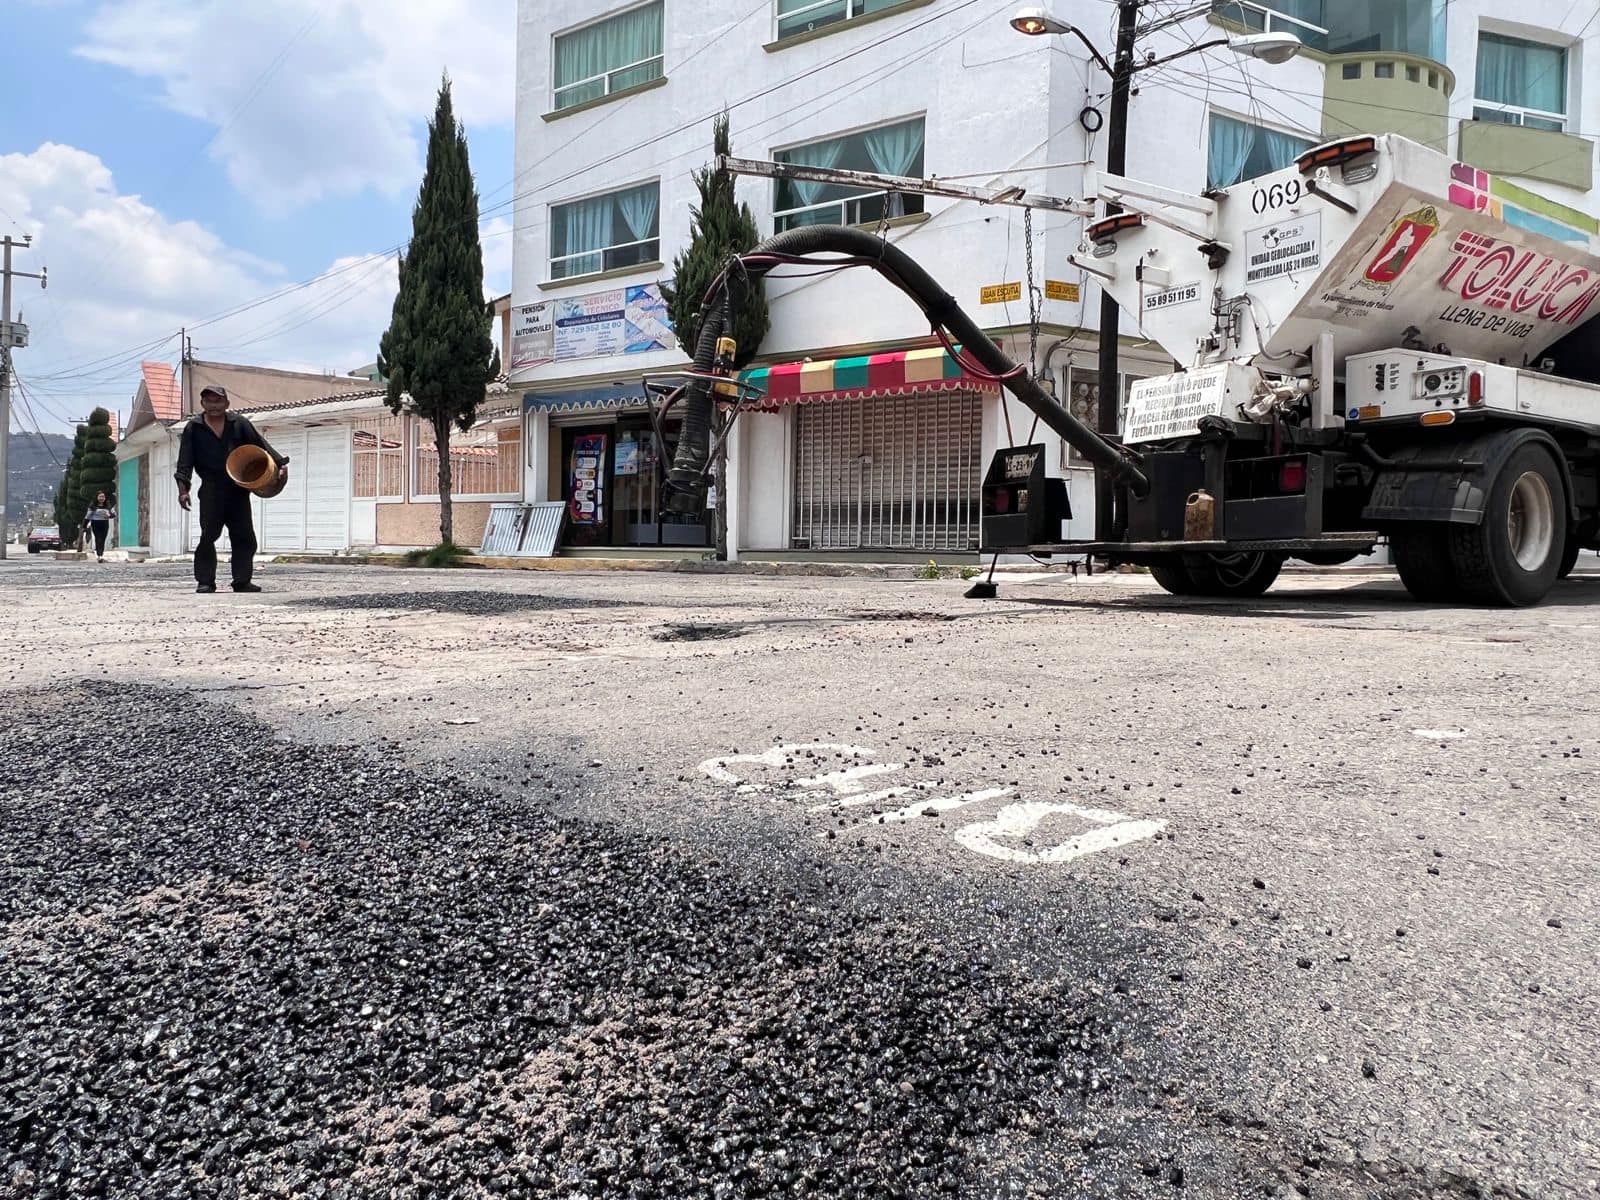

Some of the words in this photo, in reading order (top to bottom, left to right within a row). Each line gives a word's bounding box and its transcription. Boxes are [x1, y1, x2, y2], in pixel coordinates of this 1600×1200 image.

[1252, 179, 1301, 215] 069
[1279, 228, 1298, 239] GPS
[1251, 251, 1270, 266] UNIDAD
[1271, 241, 1310, 260] GEOLOCALIZADA
[1311, 240, 1315, 251] Y
[1247, 261, 1282, 281] MONITOREADA
[1283, 259, 1293, 272] LAS
[1293, 258, 1300, 270] 24
[1301, 254, 1319, 268] HORAS
[1438, 230, 1600, 325] TOLUCA
[584, 291, 622, 306] SERVICIO
[983, 287, 996, 299] JUAN
[997, 286, 1019, 297] ESCUTIA
[1147, 297, 1156, 308] 55
[1168, 293, 1176, 303] 51
[1178, 290, 1184, 301] 11
[1186, 288, 1196, 299] 95
[526, 315, 540, 324] PARA
[515, 324, 551, 336] AUTOMOVILES
[1193, 376, 1217, 391] PUEDE
[1174, 392, 1202, 406] DINERO
[1137, 411, 1160, 425] HACER
[1161, 403, 1217, 421] REPARACIONES
[1131, 426, 1152, 438] FUERA
[1154, 424, 1166, 435] DEL
